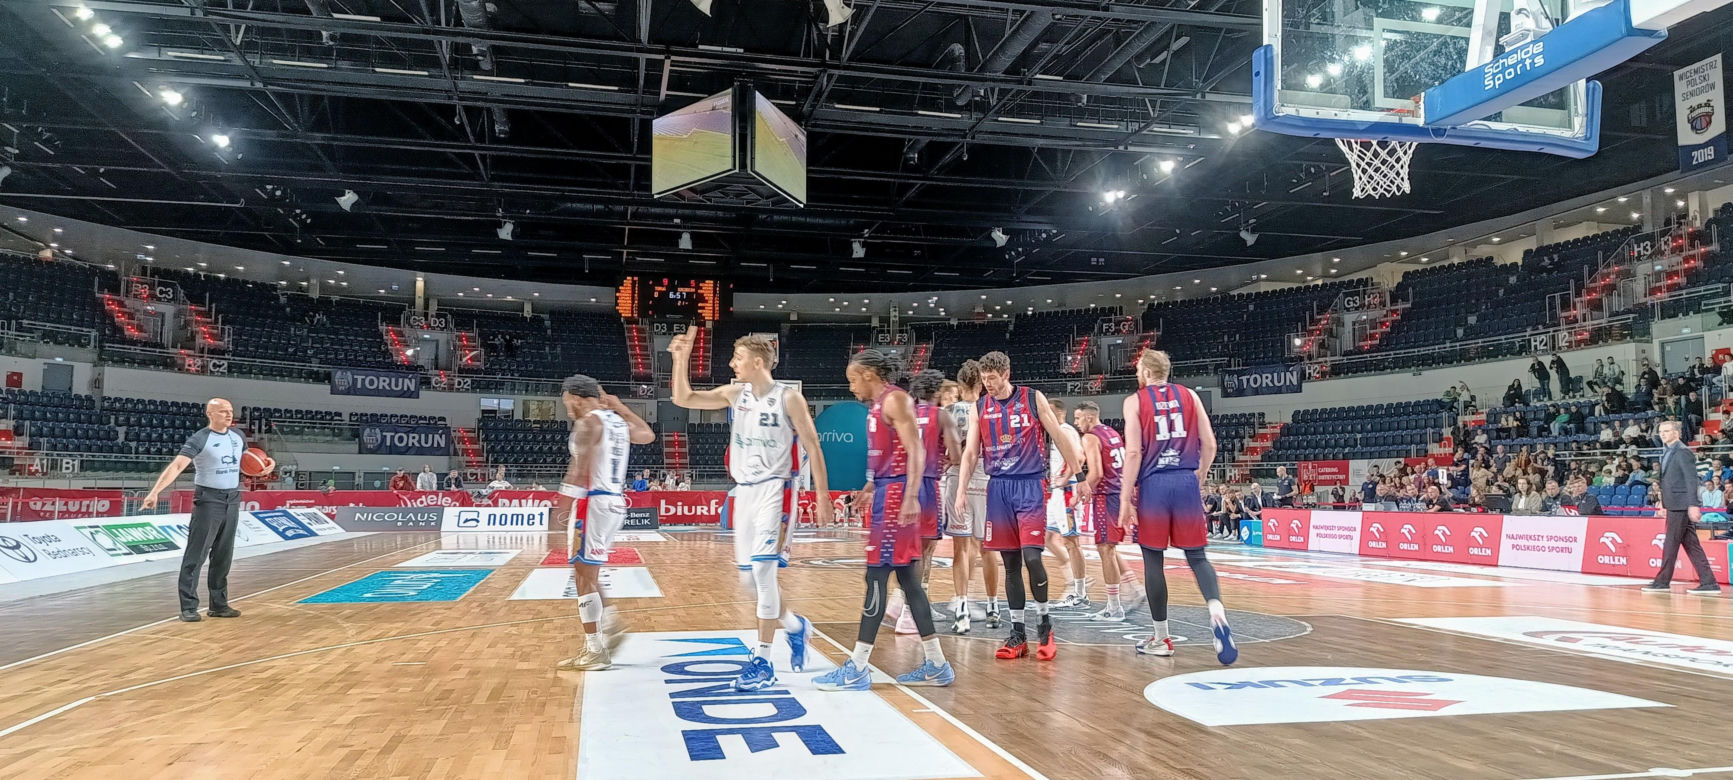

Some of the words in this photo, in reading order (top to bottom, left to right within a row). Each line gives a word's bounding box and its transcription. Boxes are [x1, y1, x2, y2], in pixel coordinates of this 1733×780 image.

[1484, 41, 1544, 78] Schelde
[1677, 59, 1718, 82] WICEMISTRZ
[1686, 73, 1710, 89] POLSKI
[1681, 81, 1716, 102] SENIORÓW
[1691, 145, 1715, 165] 2019
[1634, 240, 1651, 257] H3
[156, 286, 174, 299] C3
[1344, 296, 1360, 308] G3
[409, 315, 425, 326] C3
[430, 318, 446, 328] D3
[653, 322, 668, 333] D3
[673, 323, 687, 333] E3
[1102, 322, 1115, 332] F3
[878, 333, 890, 343] E3
[895, 333, 908, 342] F3
[1530, 337, 1547, 351] H2
[208, 359, 228, 372] C2
[1305, 364, 1320, 378] H2
[354, 375, 416, 392] TORUŃ
[432, 377, 448, 388] C2
[455, 379, 472, 389] D2
[1239, 366, 1298, 389] TORUŃ
[1067, 382, 1082, 393] F2
[759, 412, 780, 428] 21
[1009, 413, 1031, 428] 21
[1153, 412, 1187, 441] 11
[382, 430, 446, 448] TORUŃ
[31, 458, 48, 473] A1
[61, 458, 79, 473] B1
[354, 511, 438, 522] NICOLAUS
[487, 511, 545, 527] nomet
[23, 533, 62, 547] Toyota
[110, 526, 162, 543] JAWOR
[1505, 533, 1544, 543] NAJWIĘKSZY
[1546, 534, 1578, 544] SPONSOR
[1368, 541, 1387, 549] ORLEN
[1399, 542, 1419, 551] ORLEN
[1432, 544, 1454, 553] ORLEN
[1468, 547, 1492, 556] ORLEN
[1511, 543, 1546, 553] POLSKIEGO
[1547, 545, 1573, 554] SPORTU
[1597, 555, 1627, 565] ORLEN
[1649, 558, 1682, 569] ORN
[1184, 674, 1454, 691] SUZUKI
